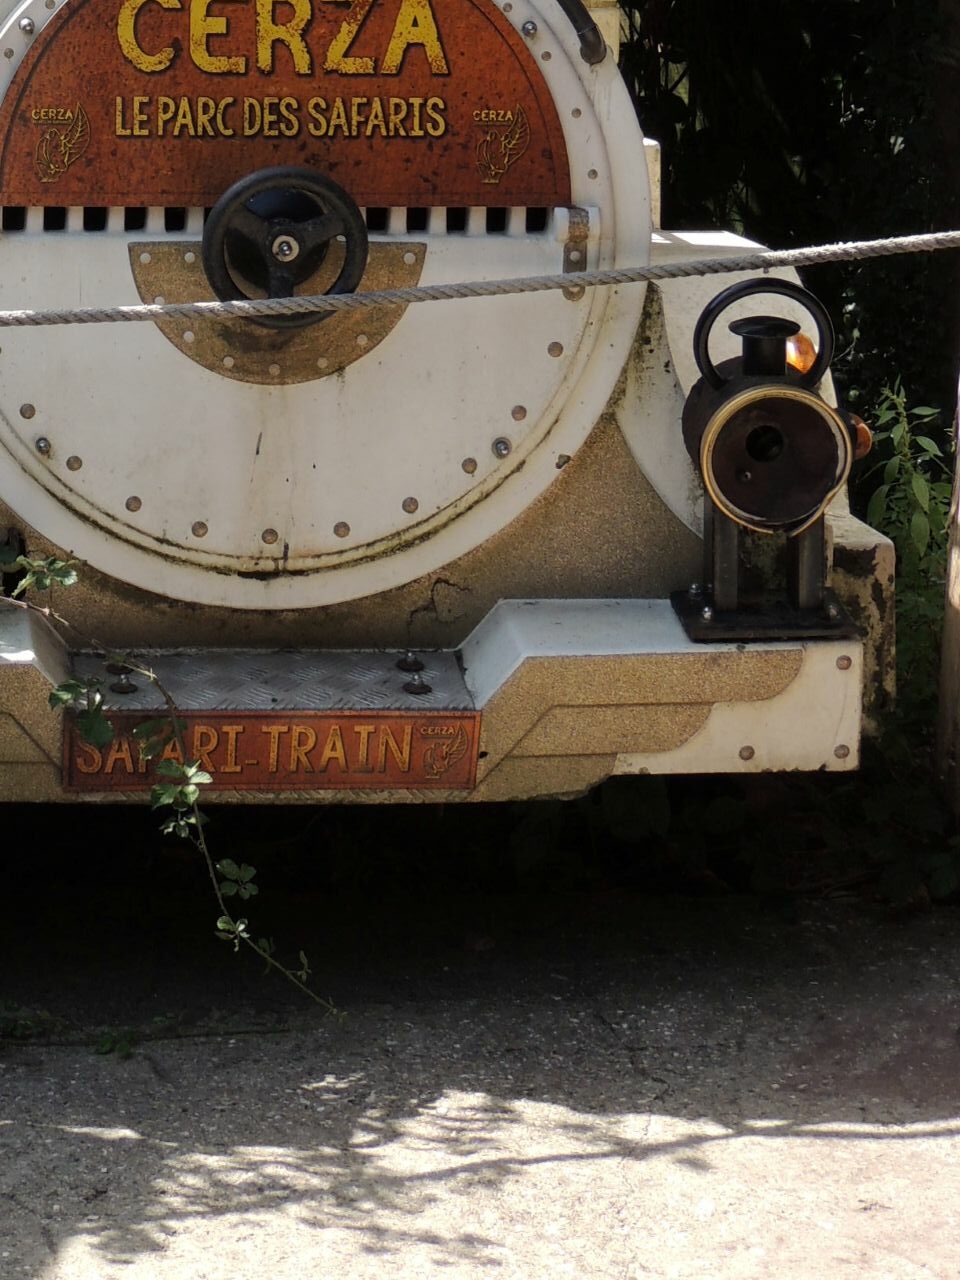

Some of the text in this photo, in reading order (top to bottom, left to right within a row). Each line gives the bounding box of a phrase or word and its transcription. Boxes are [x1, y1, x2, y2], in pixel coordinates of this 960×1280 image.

[31, 108, 74, 120] CERZA
[115, 96, 447, 137] LE PARC DES SAFARIS
[472, 109, 514, 121] CERZA
[420, 725, 455, 735] CERZA
